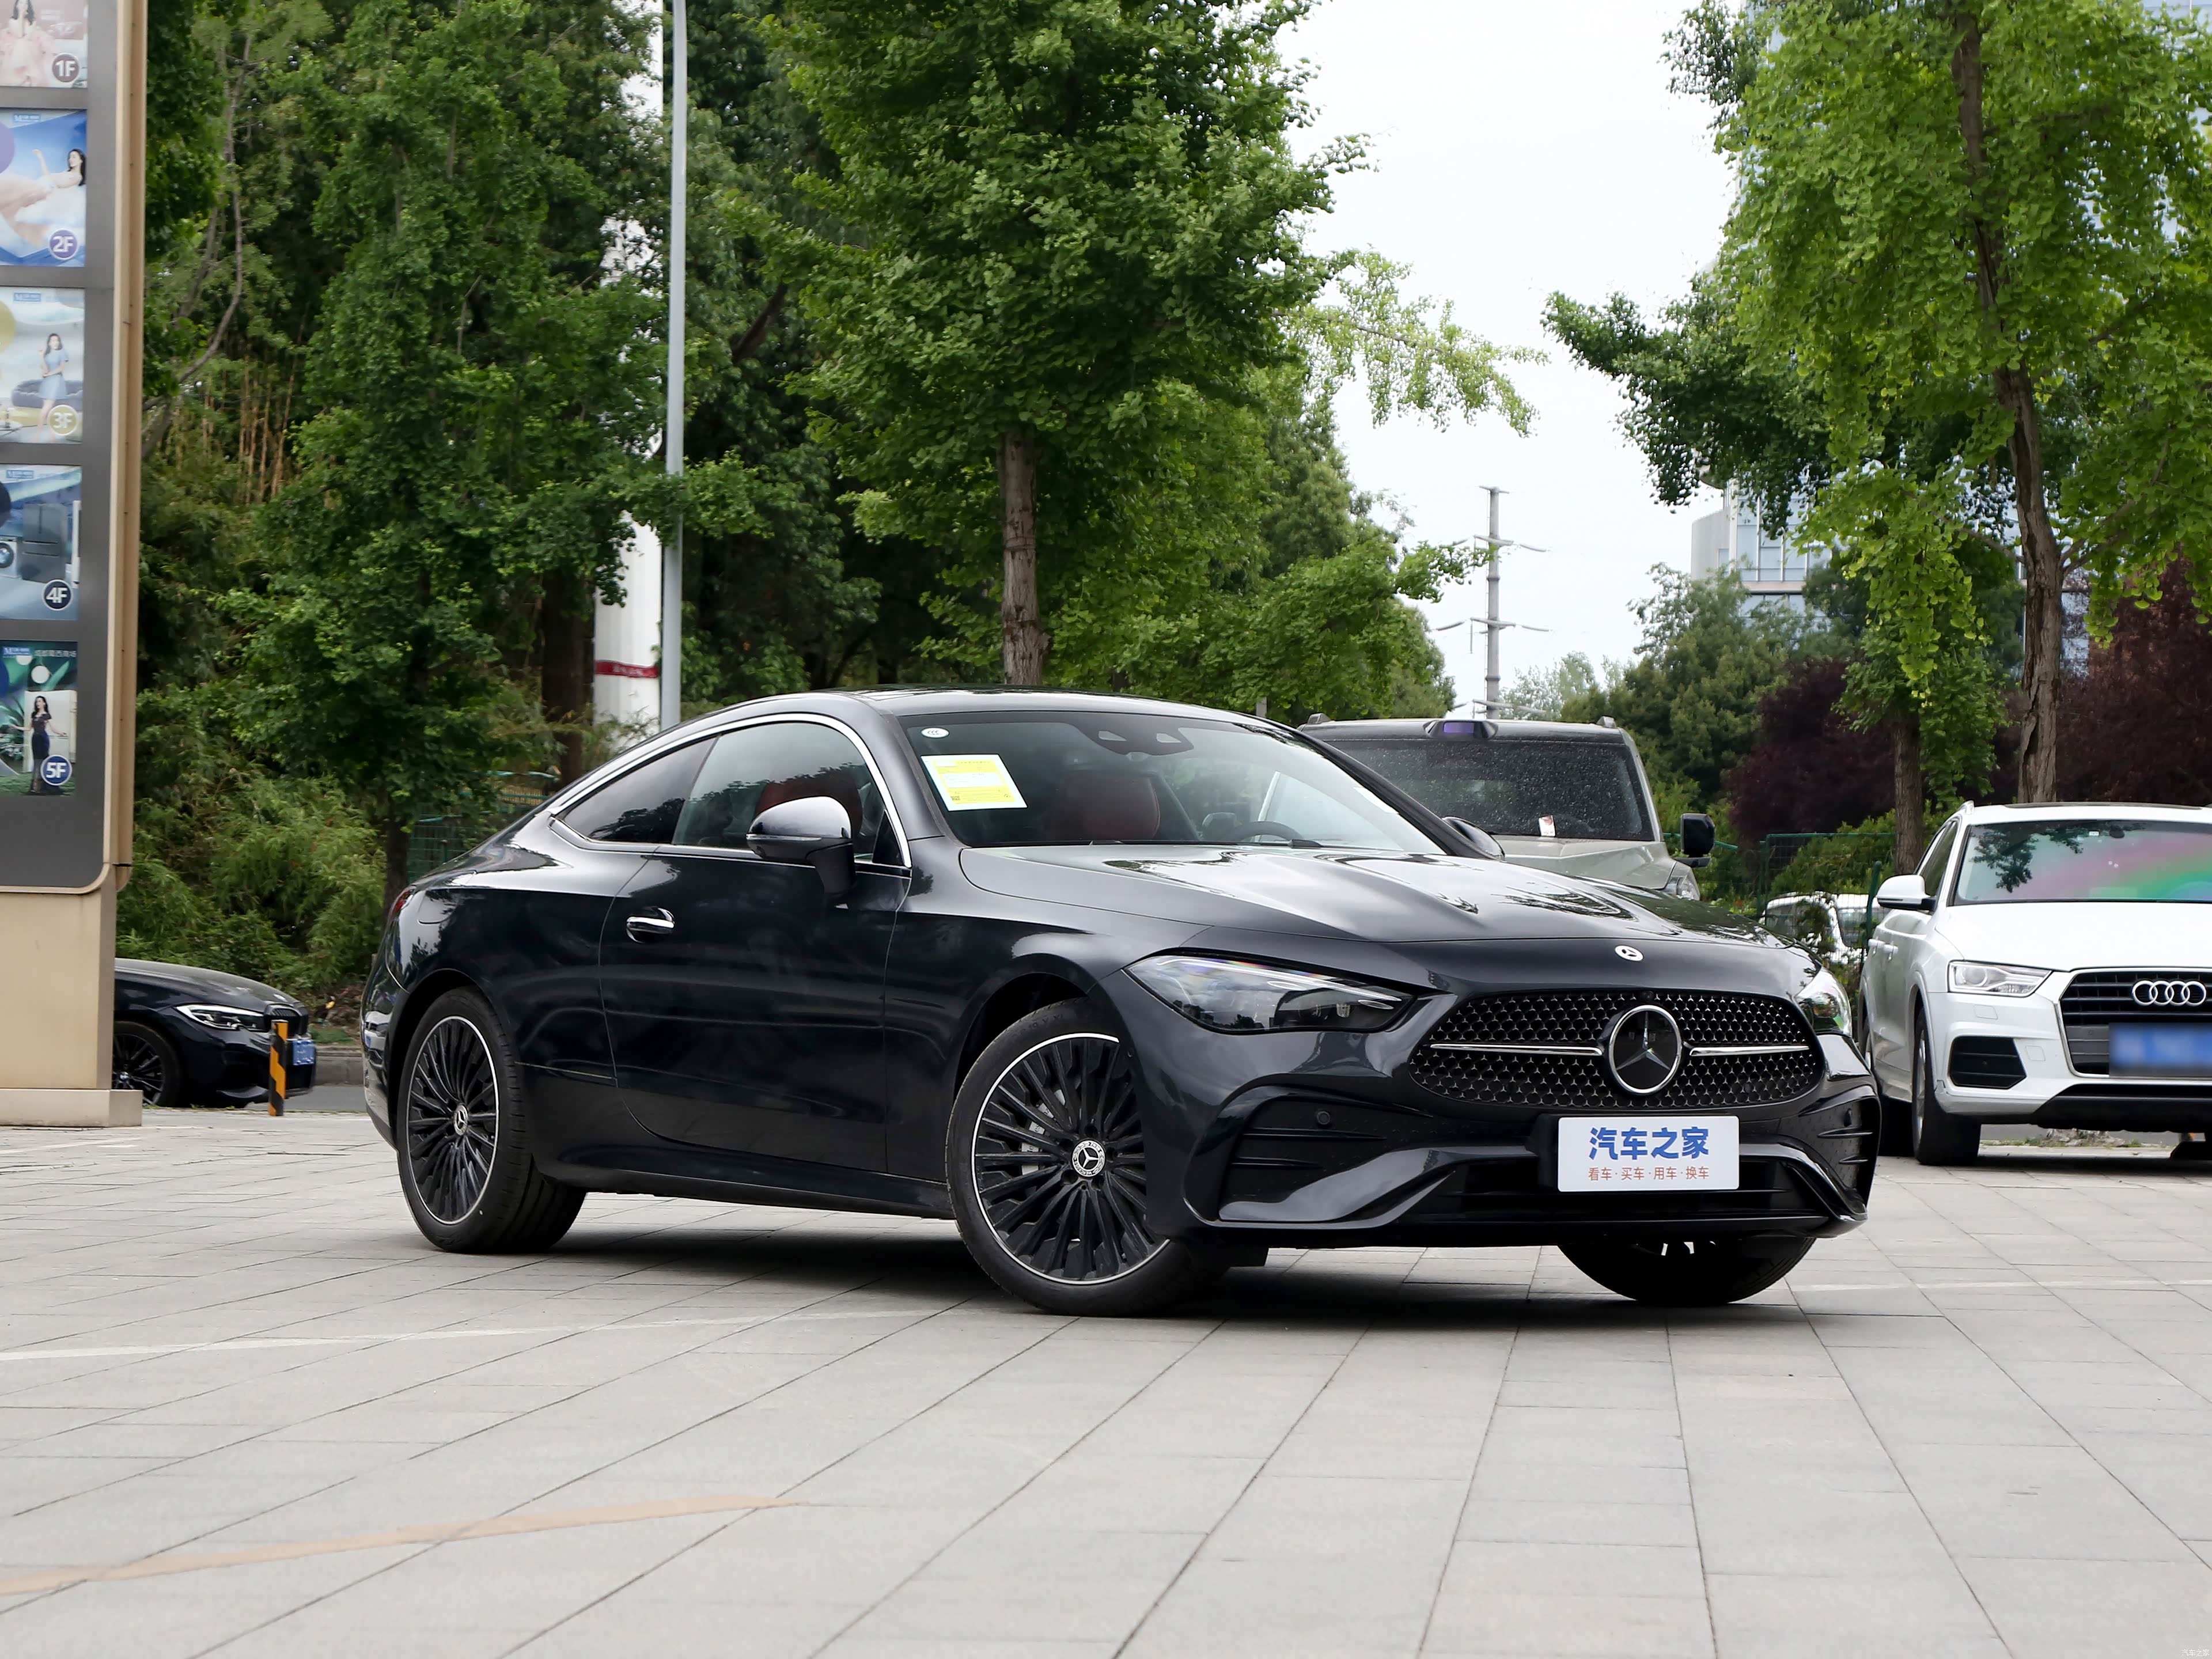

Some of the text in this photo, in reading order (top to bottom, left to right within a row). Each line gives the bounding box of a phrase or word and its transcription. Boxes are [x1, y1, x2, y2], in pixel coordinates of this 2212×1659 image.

[55, 60, 76, 77] 1F
[52, 236, 74, 252] 2F
[54, 412, 73, 429] 3F
[46, 587, 68, 603] 4F
[46, 762, 67, 778] 5F
[1589, 1126, 1709, 1160] 汽车之家
